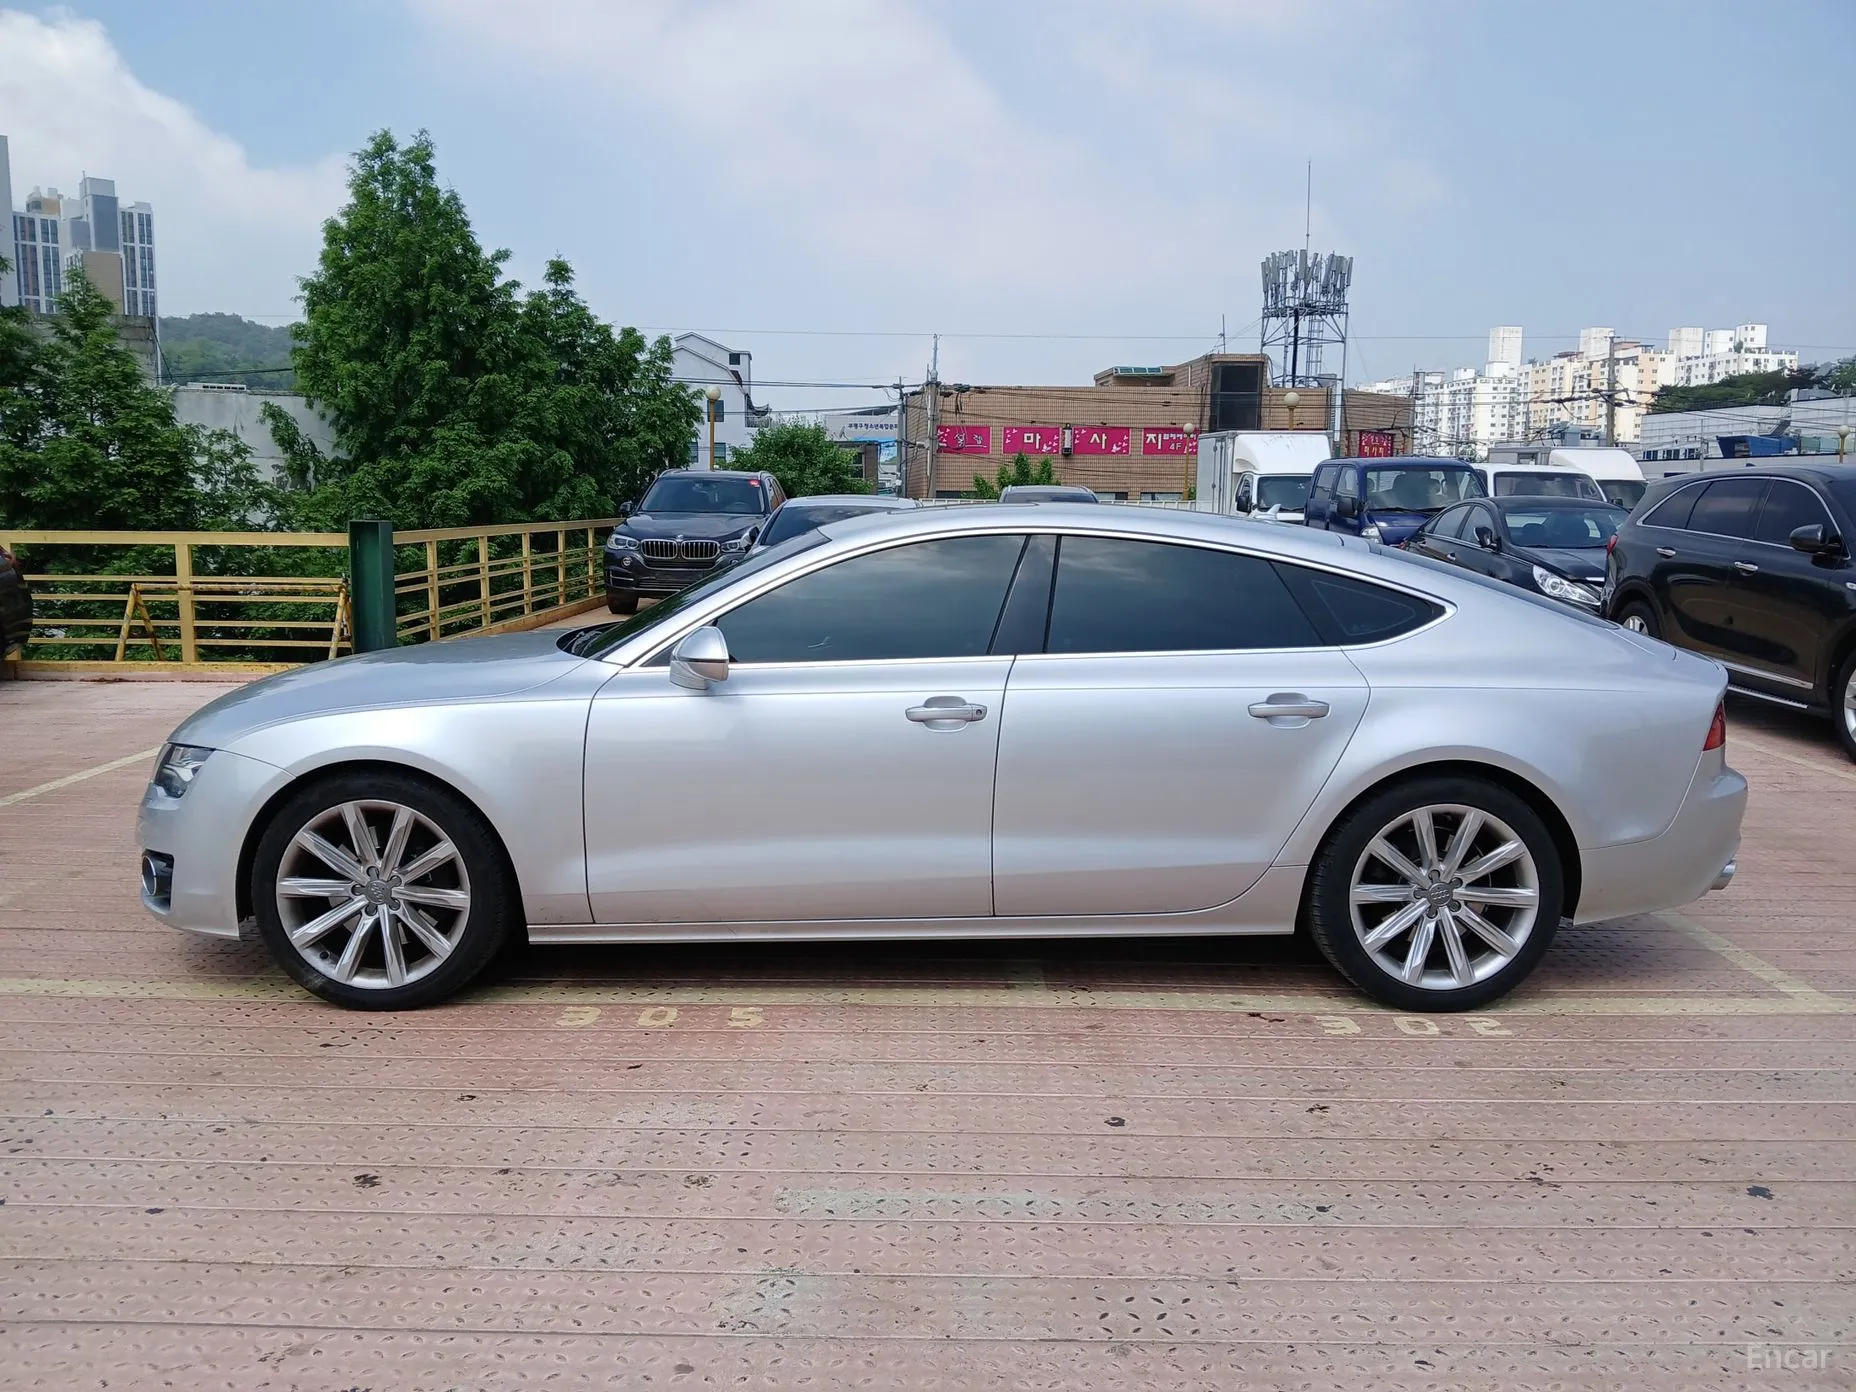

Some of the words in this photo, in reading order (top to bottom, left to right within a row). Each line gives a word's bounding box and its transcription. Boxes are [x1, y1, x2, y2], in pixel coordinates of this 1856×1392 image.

[1023, 433, 1041, 449] 마
[1089, 433, 1107, 449] 사
[1145, 433, 1162, 450] 지
